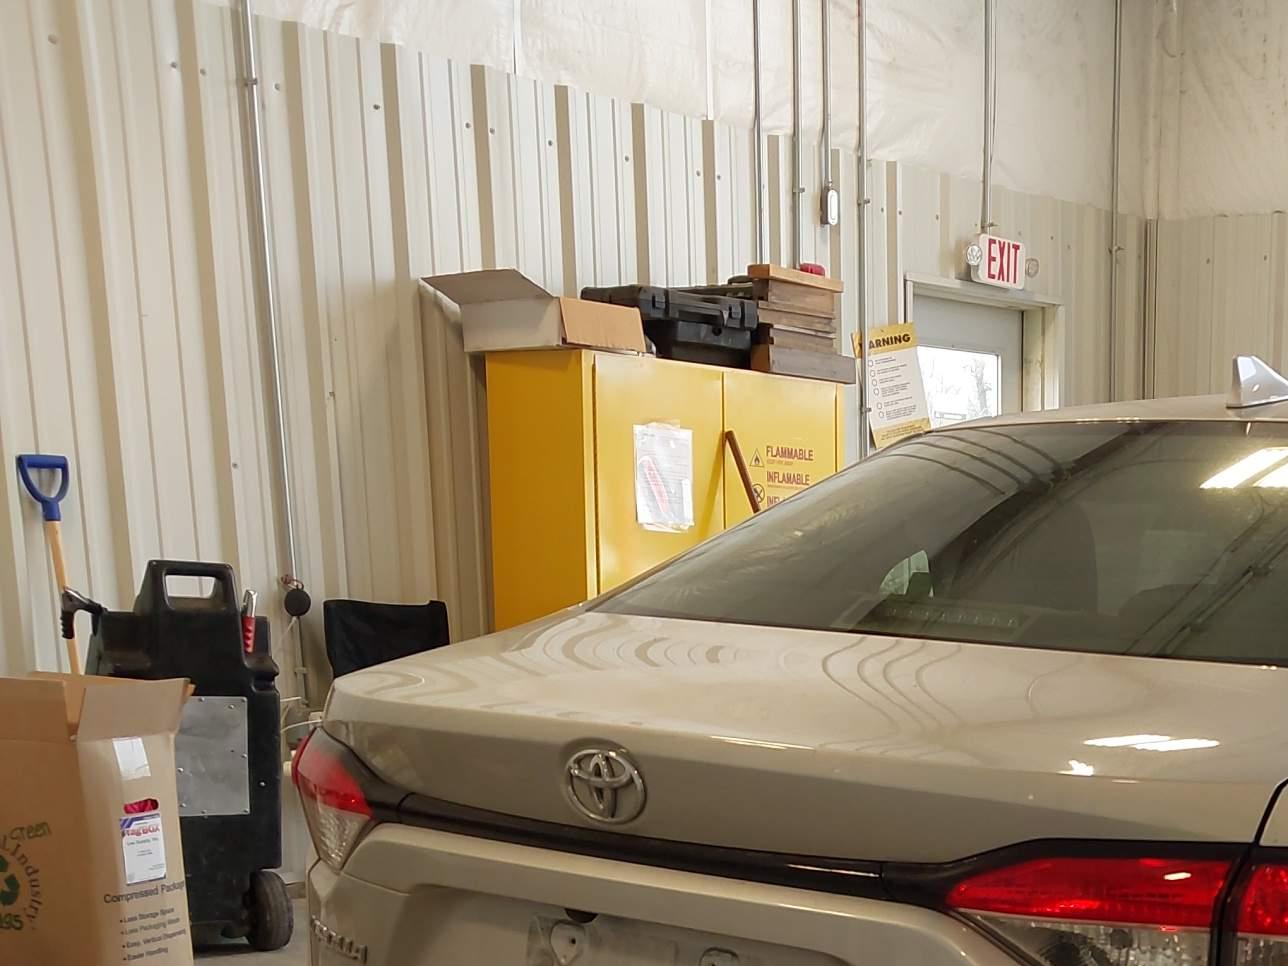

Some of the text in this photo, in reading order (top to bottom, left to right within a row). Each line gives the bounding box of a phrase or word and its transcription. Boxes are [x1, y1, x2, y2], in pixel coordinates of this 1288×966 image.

[988, 238, 1020, 284] EXIT
[859, 333, 911, 350] ARNING
[766, 446, 814, 461] FLAMMABLE
[766, 471, 810, 486] INFLAMABLE
[103, 884, 159, 904] Compressed
